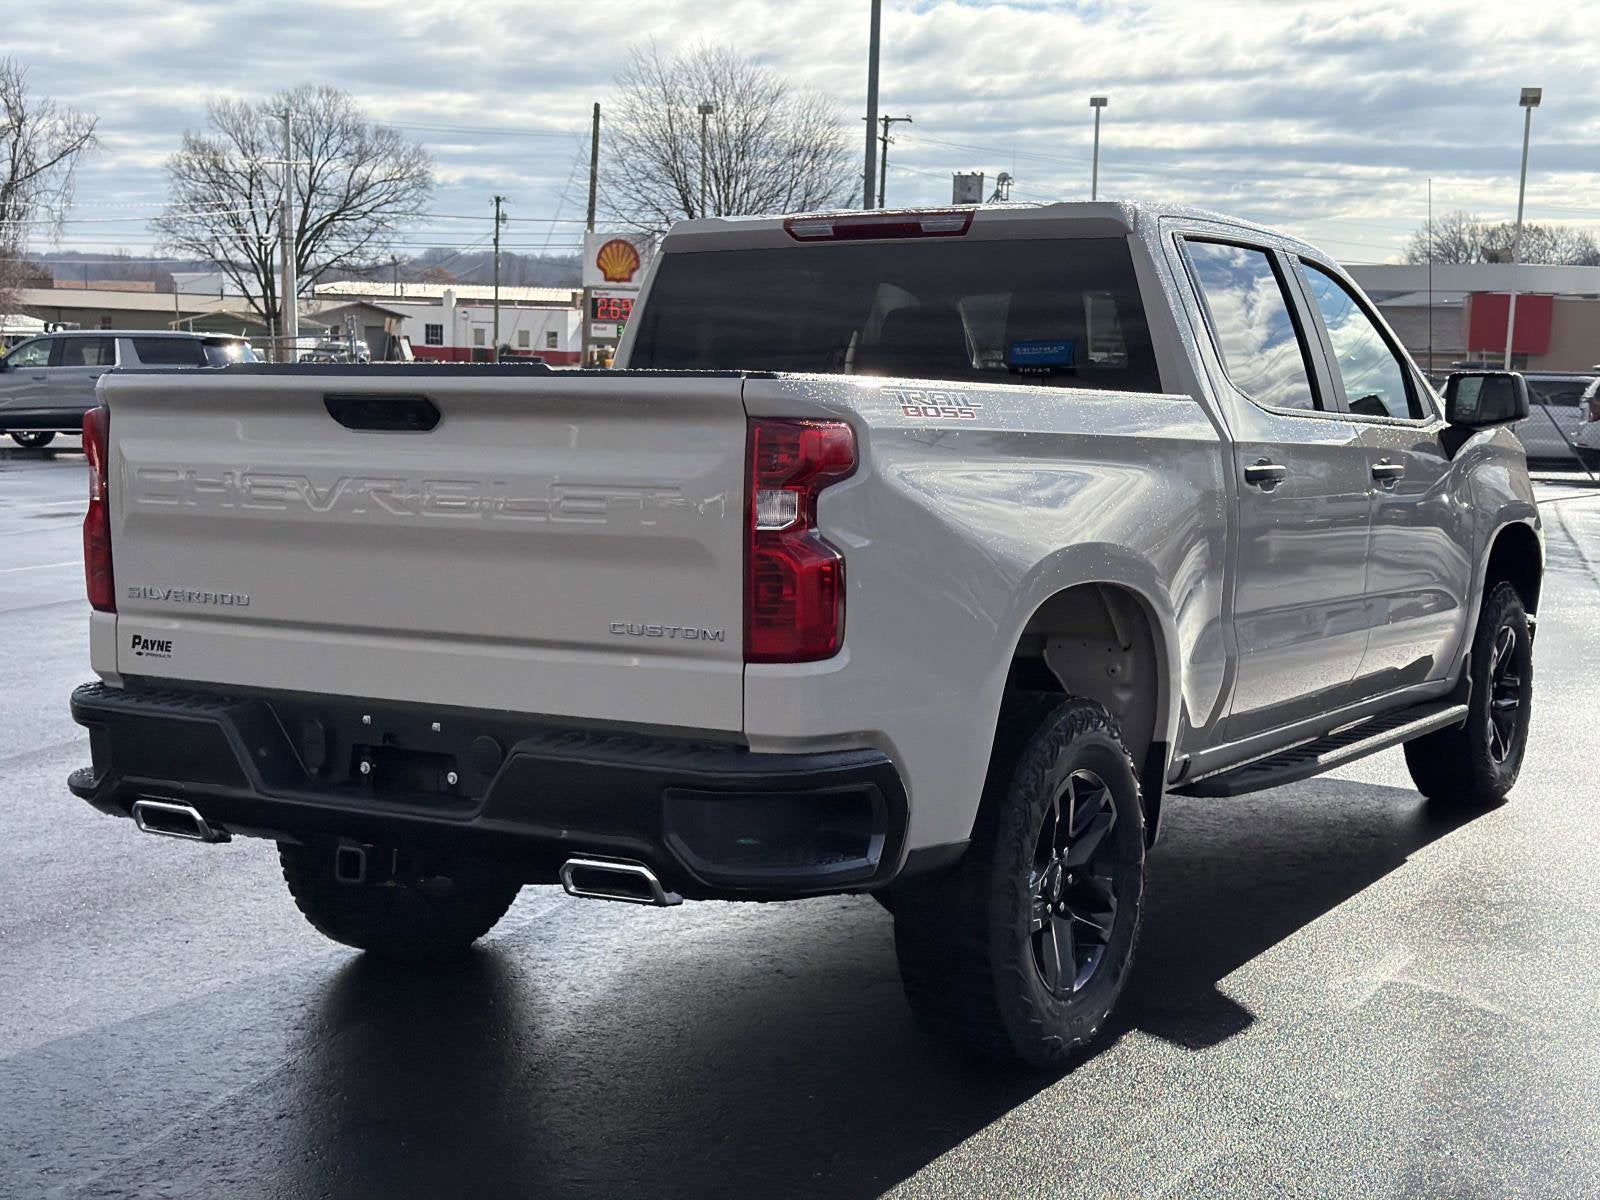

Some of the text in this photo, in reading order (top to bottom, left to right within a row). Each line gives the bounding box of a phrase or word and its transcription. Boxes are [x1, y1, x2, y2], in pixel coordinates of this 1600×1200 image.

[880, 388, 983, 409] TRAIL
[901, 405, 977, 420] BOSS
[137, 469, 683, 525] CHEVROLET
[127, 587, 250, 606] SILVERADO
[608, 622, 725, 642] CUSTOM
[131, 634, 173, 653] PAYNE
